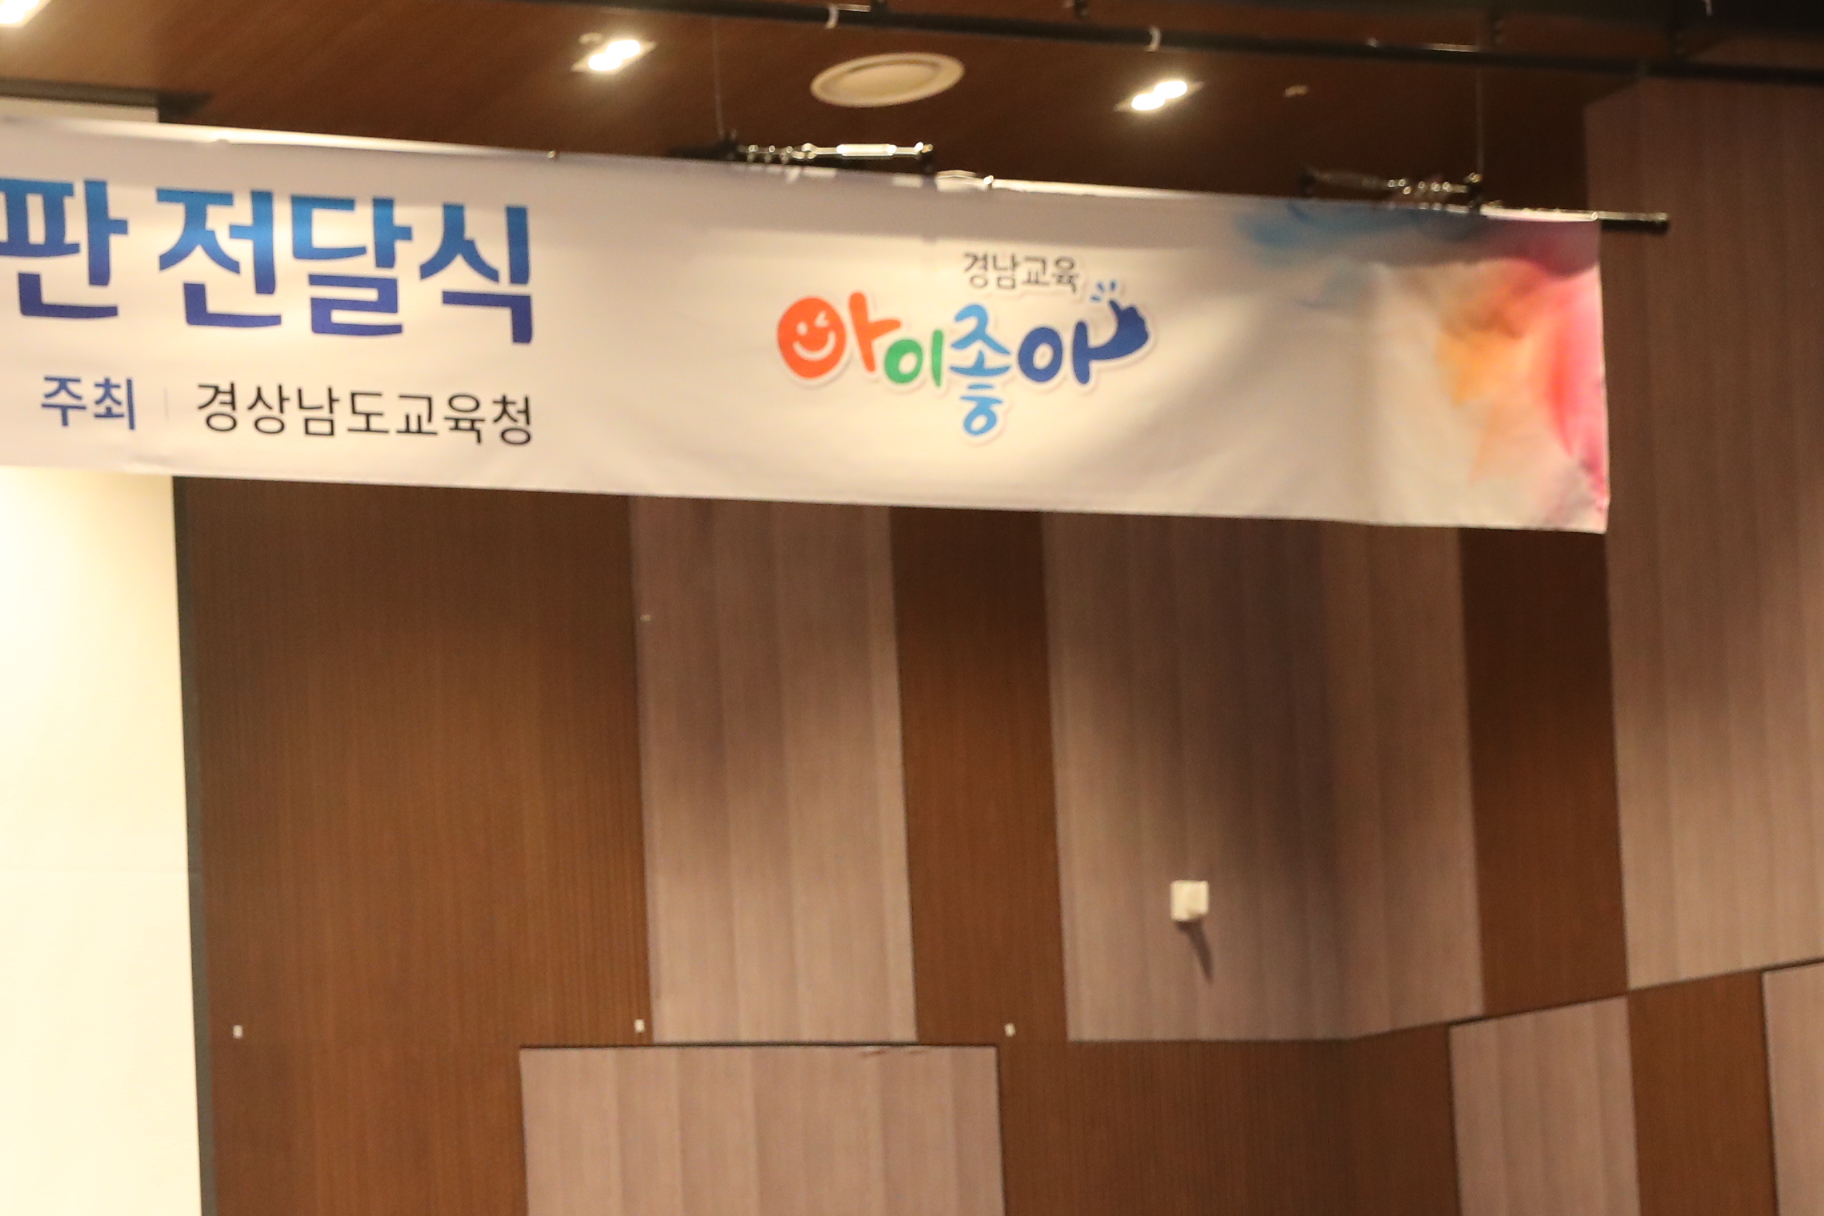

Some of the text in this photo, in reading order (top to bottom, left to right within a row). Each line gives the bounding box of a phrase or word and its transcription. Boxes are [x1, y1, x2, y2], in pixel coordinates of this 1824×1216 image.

[155, 188, 534, 344] 전달식
[964, 252, 1078, 293] 경남교육
[40, 376, 136, 430] 주최
[197, 382, 533, 446] 경상남도교육청
[776, 290, 1150, 436] 아이좋아
